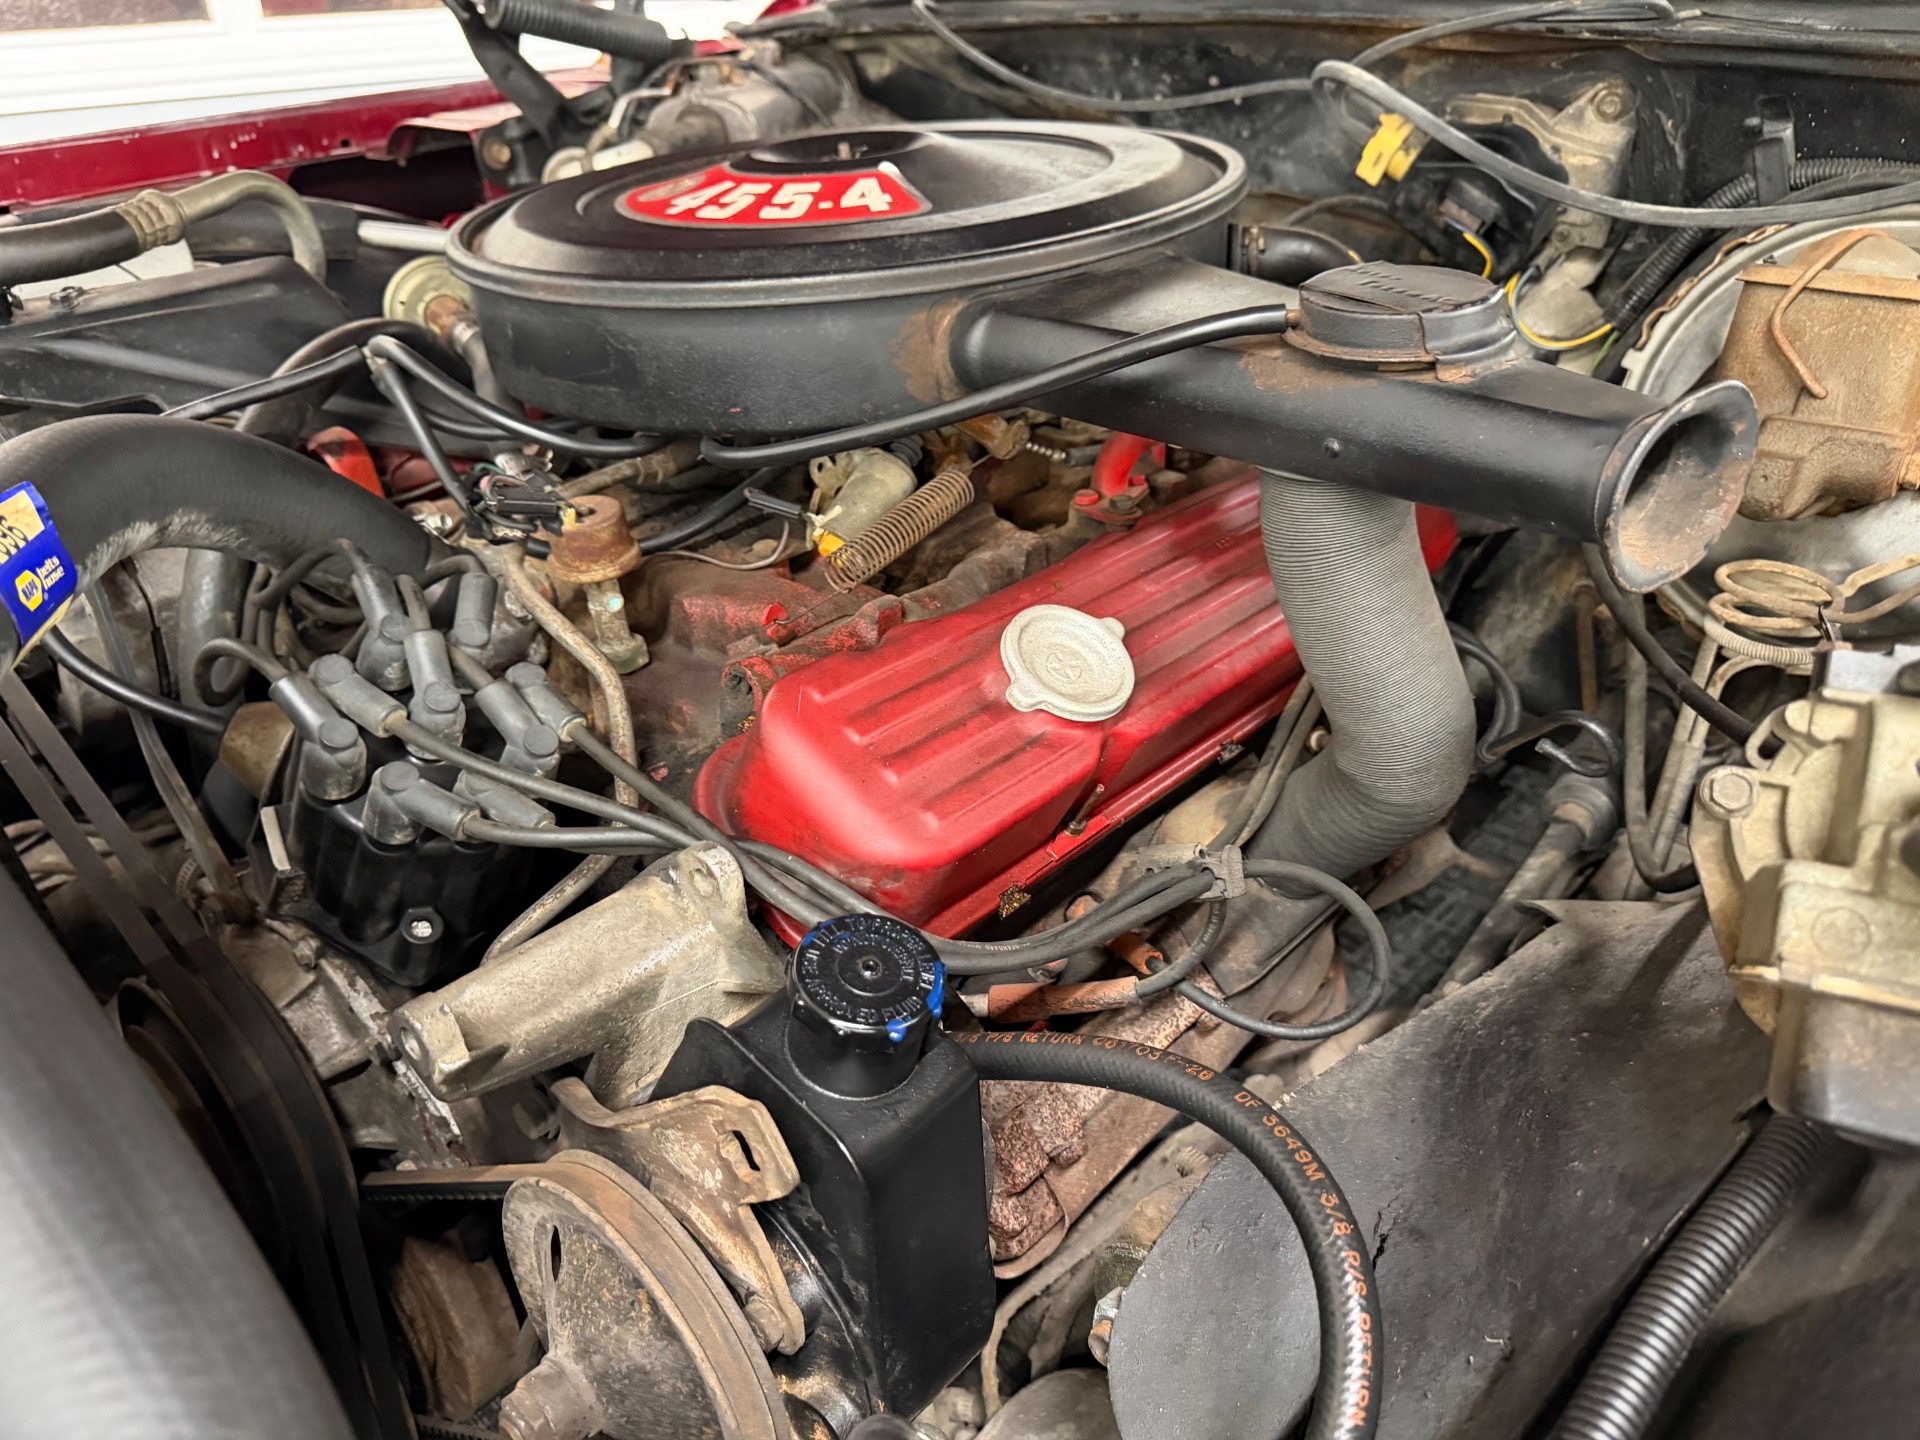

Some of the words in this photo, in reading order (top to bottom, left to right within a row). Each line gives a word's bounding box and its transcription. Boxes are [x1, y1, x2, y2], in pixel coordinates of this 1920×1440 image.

[36, 555, 60, 578] belts
[21, 578, 40, 603] NAPA
[801, 948, 821, 975] USE
[804, 978, 879, 1022] APPROVED
[881, 995, 924, 1023] FLUID
[1019, 1031, 1086, 1046] RETURN
[1233, 1091, 1262, 1107] DF
[1262, 1114, 1325, 1181] 3649M
[1320, 1192, 1352, 1236] 3/8
[1350, 1311, 1373, 1427] RETURN
